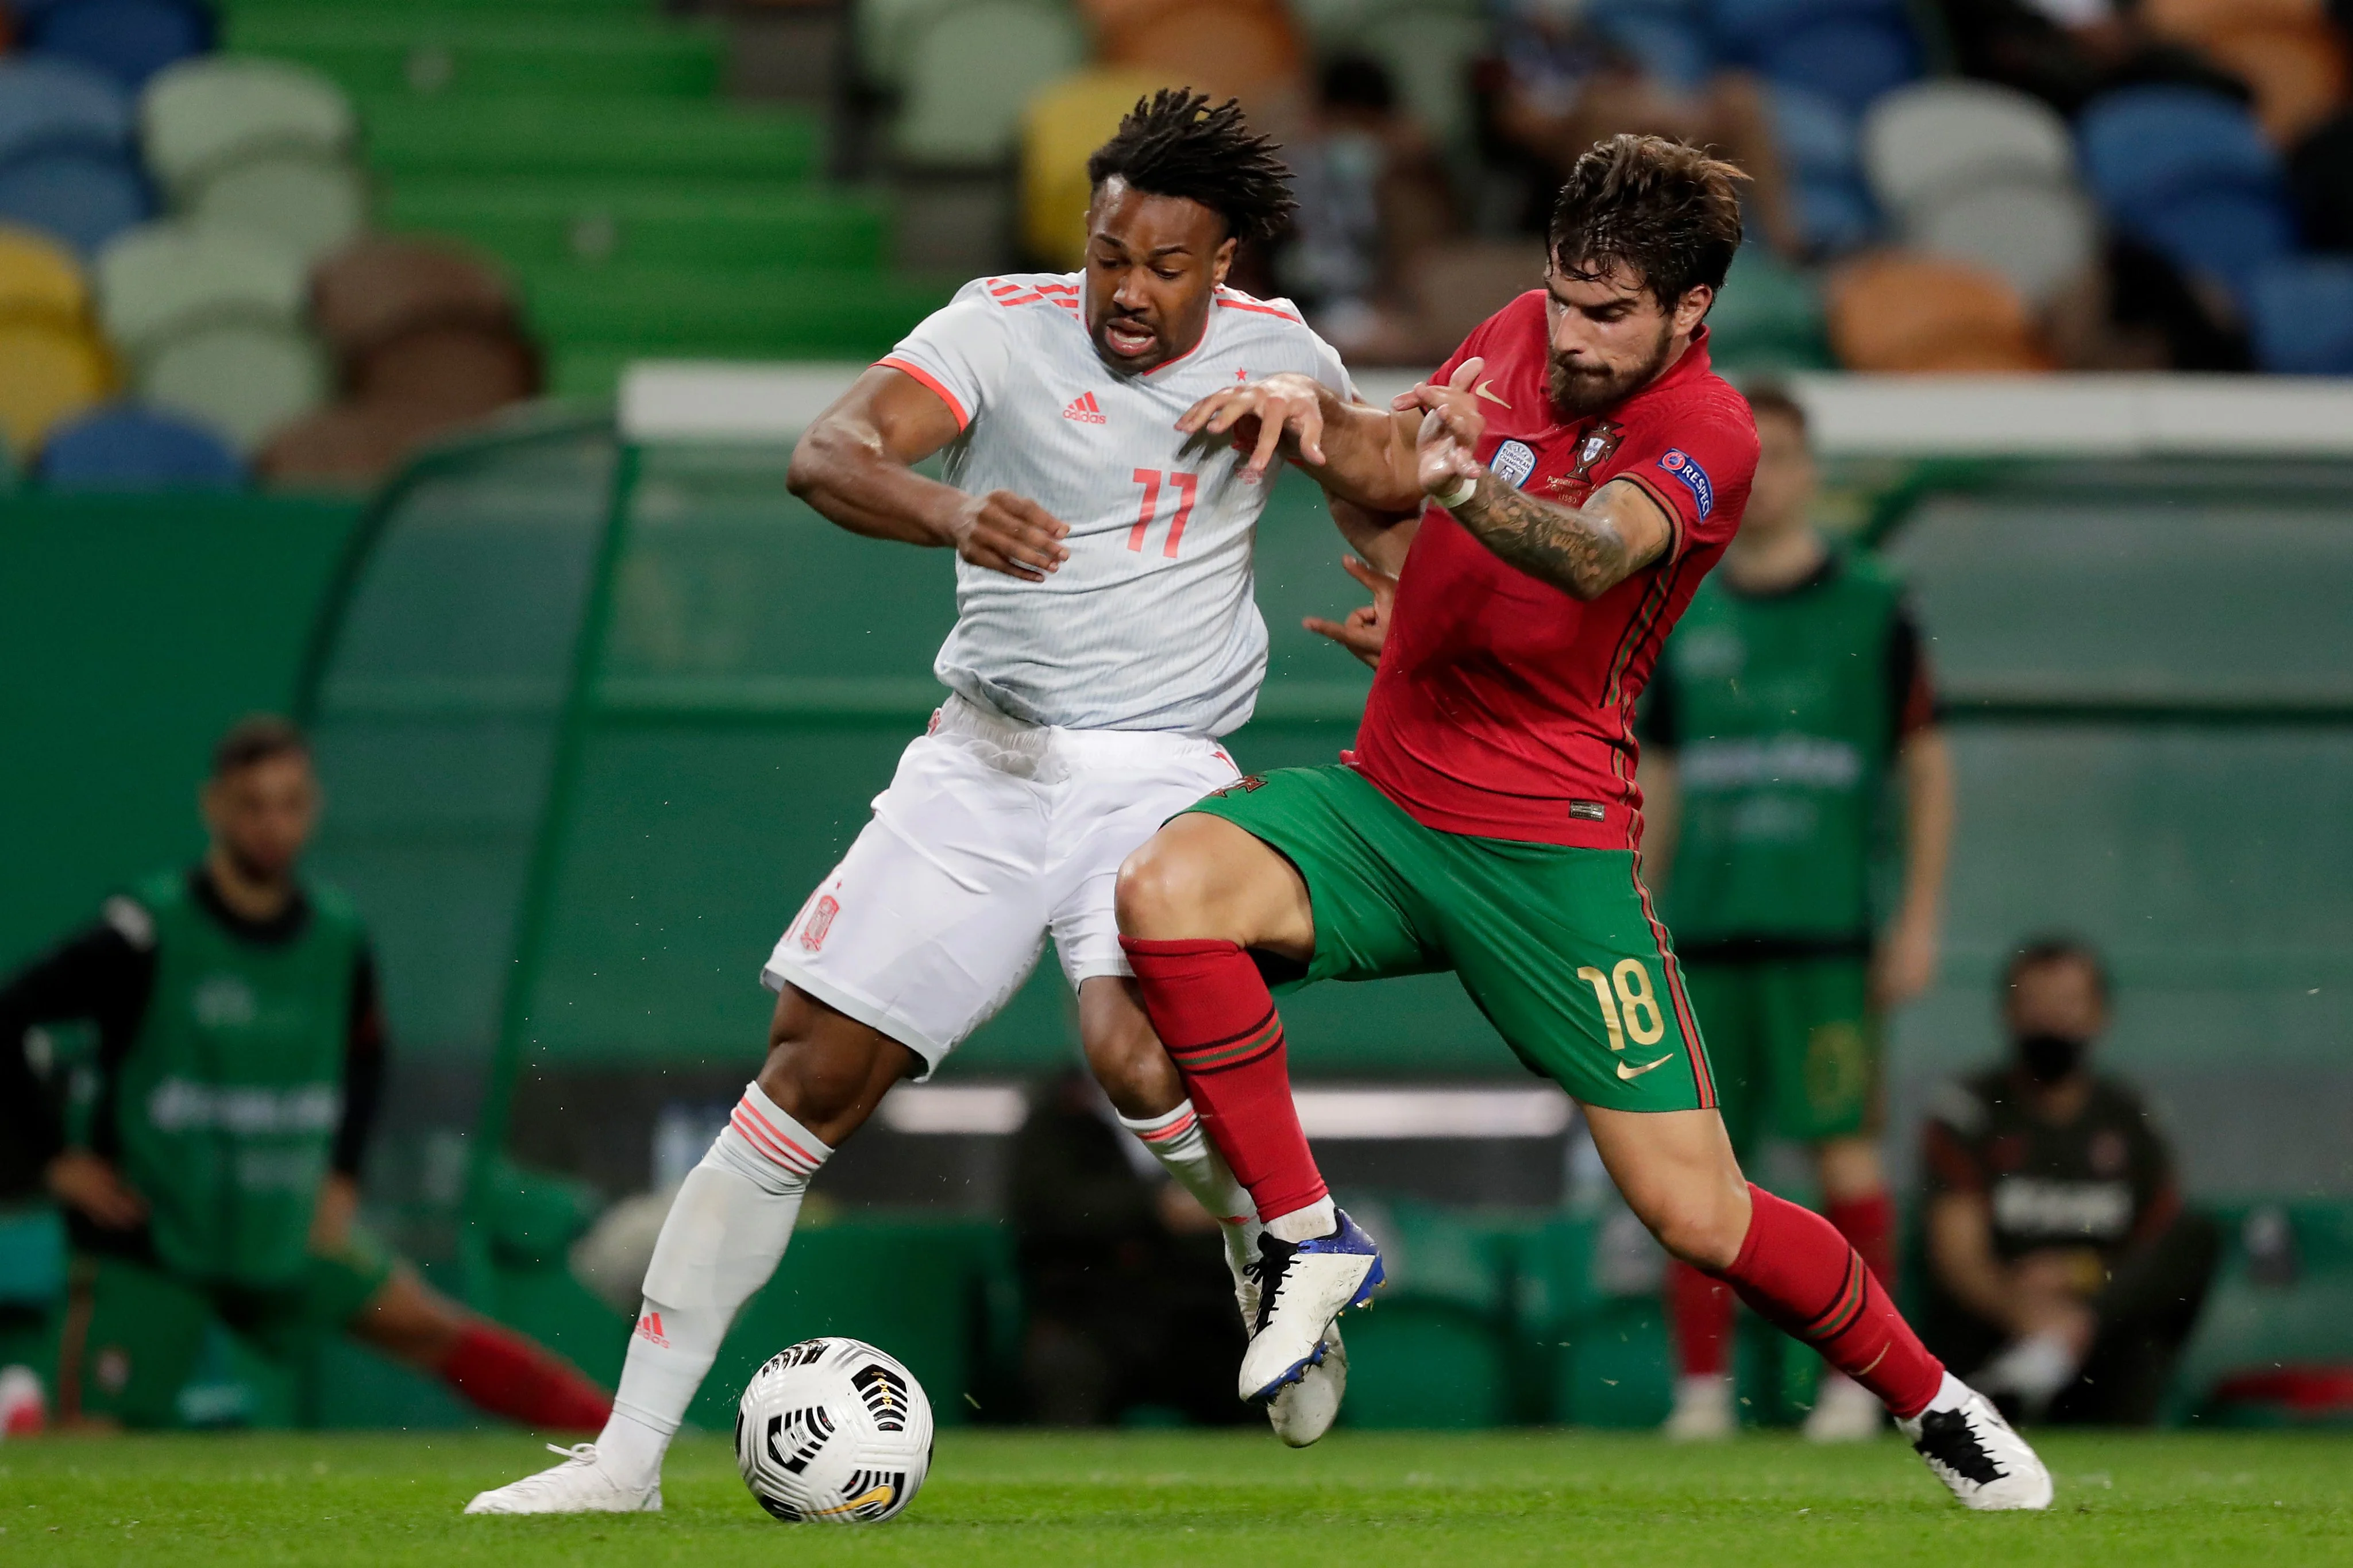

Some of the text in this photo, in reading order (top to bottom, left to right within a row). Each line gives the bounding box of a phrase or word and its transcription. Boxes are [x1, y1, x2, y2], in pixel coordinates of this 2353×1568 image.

[1062, 410, 1106, 424] adidas
[1499, 454, 1527, 474] CHAMPIONS
[1503, 449, 1530, 469] EUROPEAN
[1682, 465, 1710, 517] RESPECT
[1577, 958, 1664, 1051] 18
